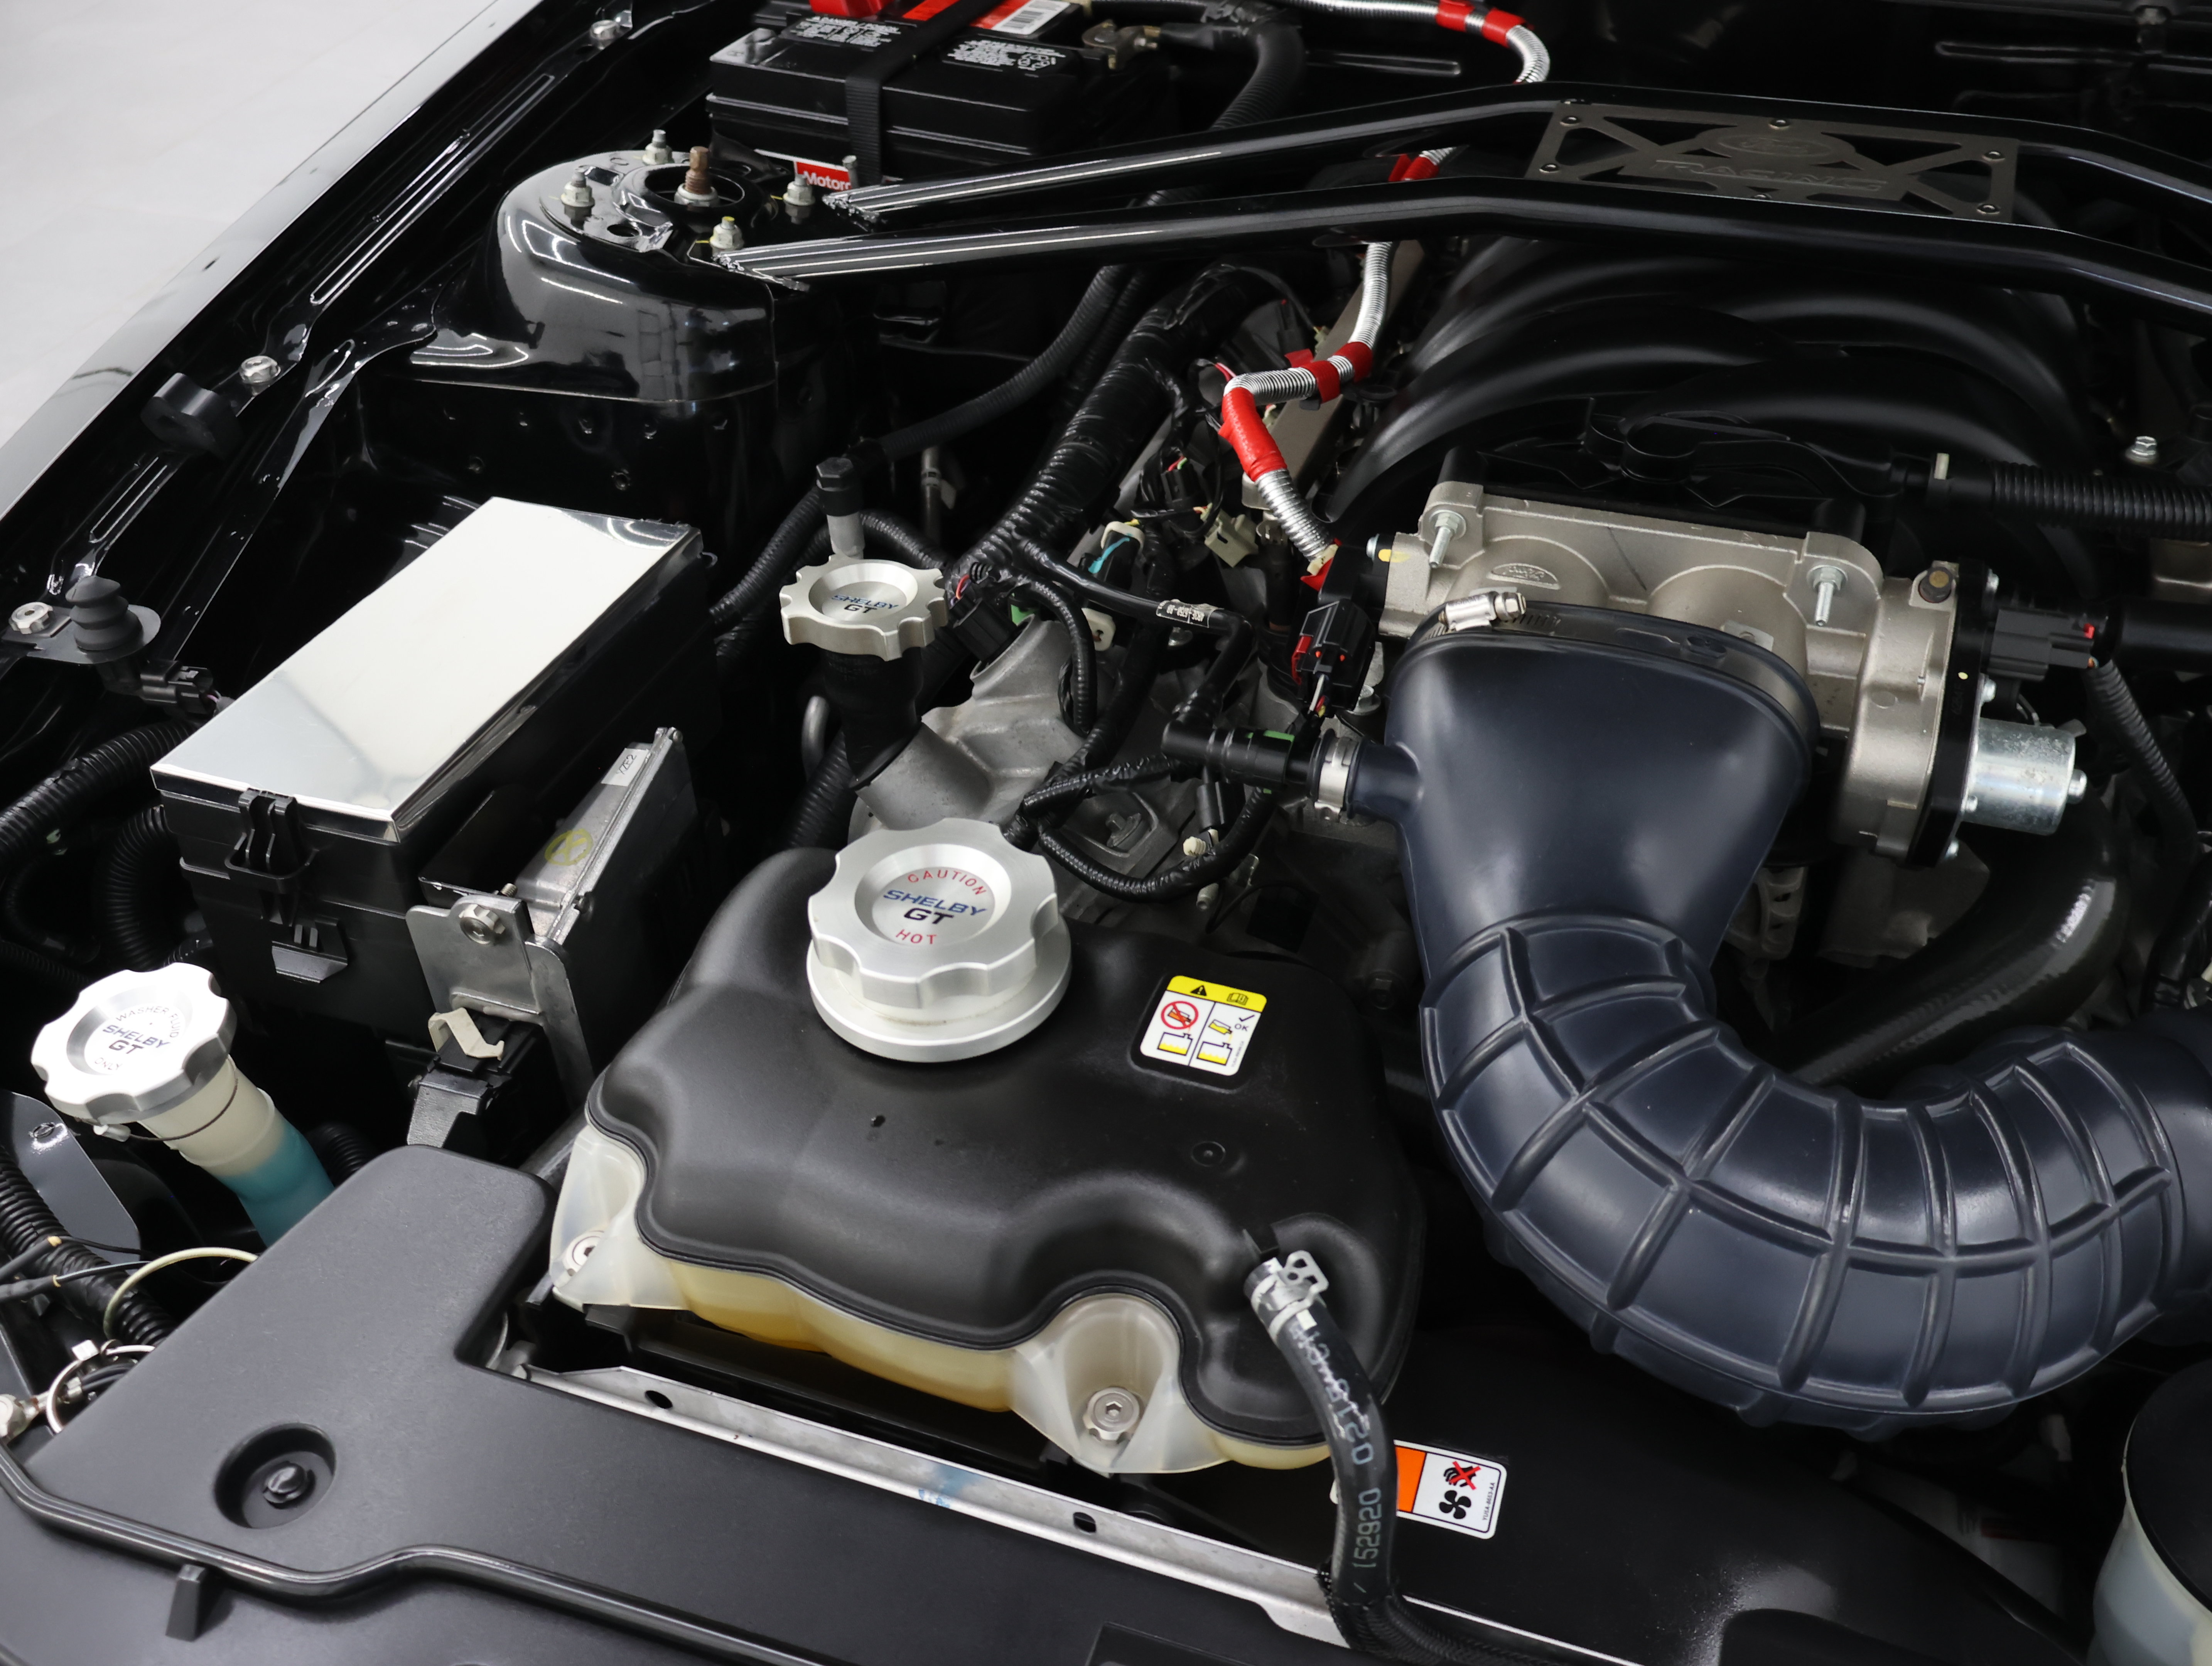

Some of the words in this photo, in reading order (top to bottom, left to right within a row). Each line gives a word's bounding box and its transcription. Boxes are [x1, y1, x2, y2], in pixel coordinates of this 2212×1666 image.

[1651, 159, 1888, 192] RACING
[831, 594, 899, 609] SHELBY
[844, 604, 877, 614] GT
[907, 869, 987, 895] CAUTION
[883, 889, 989, 916] SHELBY
[903, 908, 954, 925] GT
[896, 929, 938, 945] HOT
[116, 1006, 169, 1022] WASHER
[170, 1012, 180, 1039] FLUID
[1234, 1023, 1249, 1032] OK
[103, 1025, 171, 1049] SHELBY
[109, 1040, 145, 1055] GT
[94, 1057, 123, 1071] ONLY
[1353, 1487, 1382, 1569] 152920
